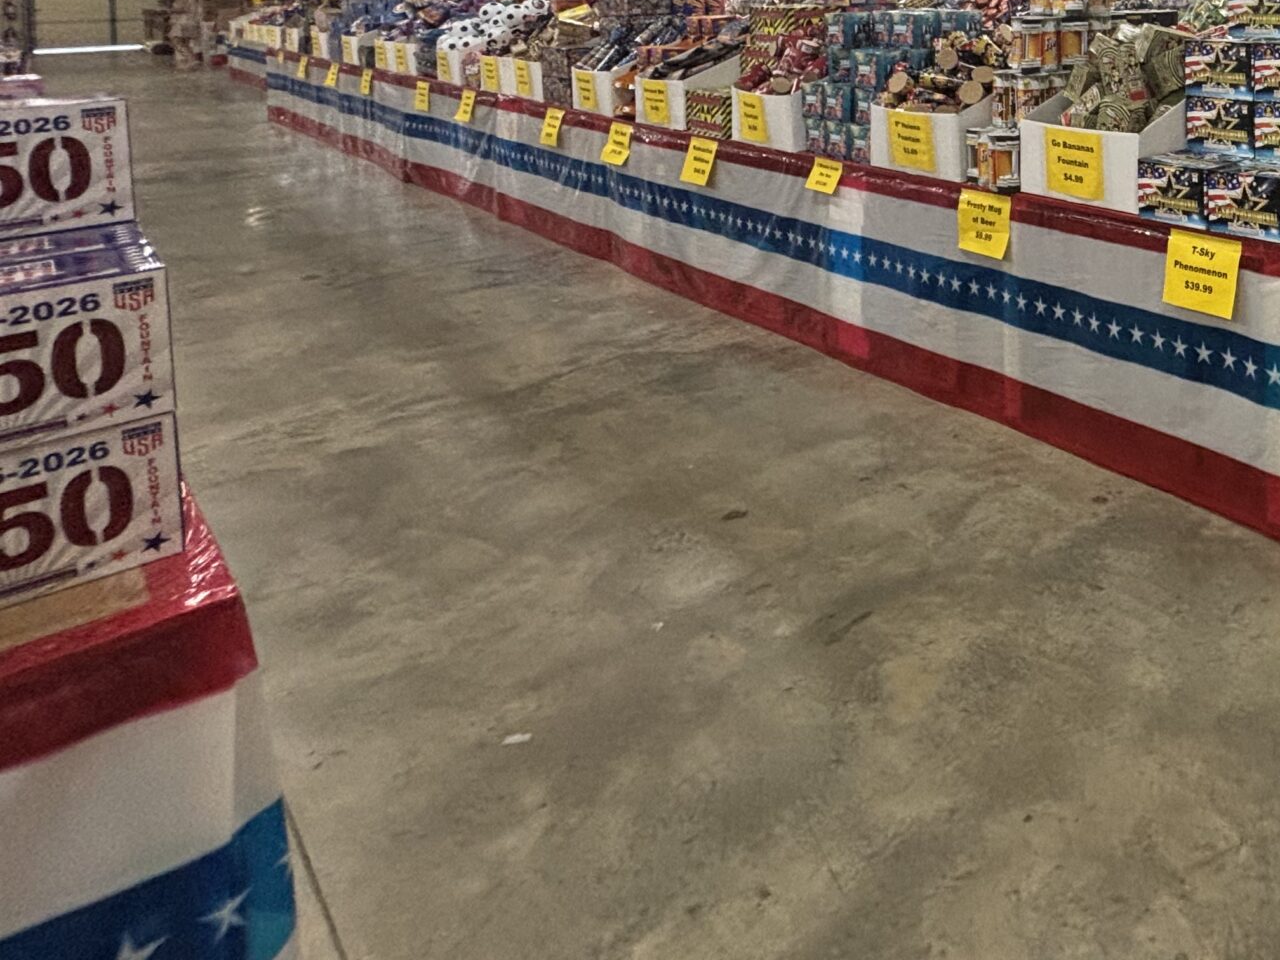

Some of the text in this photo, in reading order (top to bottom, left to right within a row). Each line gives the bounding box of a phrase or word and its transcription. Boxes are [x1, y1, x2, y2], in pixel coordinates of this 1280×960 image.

[82, 115, 118, 135] USA
[1051, 139, 1095, 154] Go Bananas
[1057, 155, 1089, 169] Fountain
[966, 200, 1002, 216] Frosty Mug
[972, 216, 996, 227] of Beer
[1191, 245, 1217, 261] T-Sky
[1173, 259, 1229, 280] Phenomenon
[1184, 280, 1214, 295] $39.99
[112, 288, 155, 312] USA
[138, 314, 154, 383] FOUNTAIN
[121, 431, 165, 457] USA
[147, 457, 162, 525] FOUNTAIN
